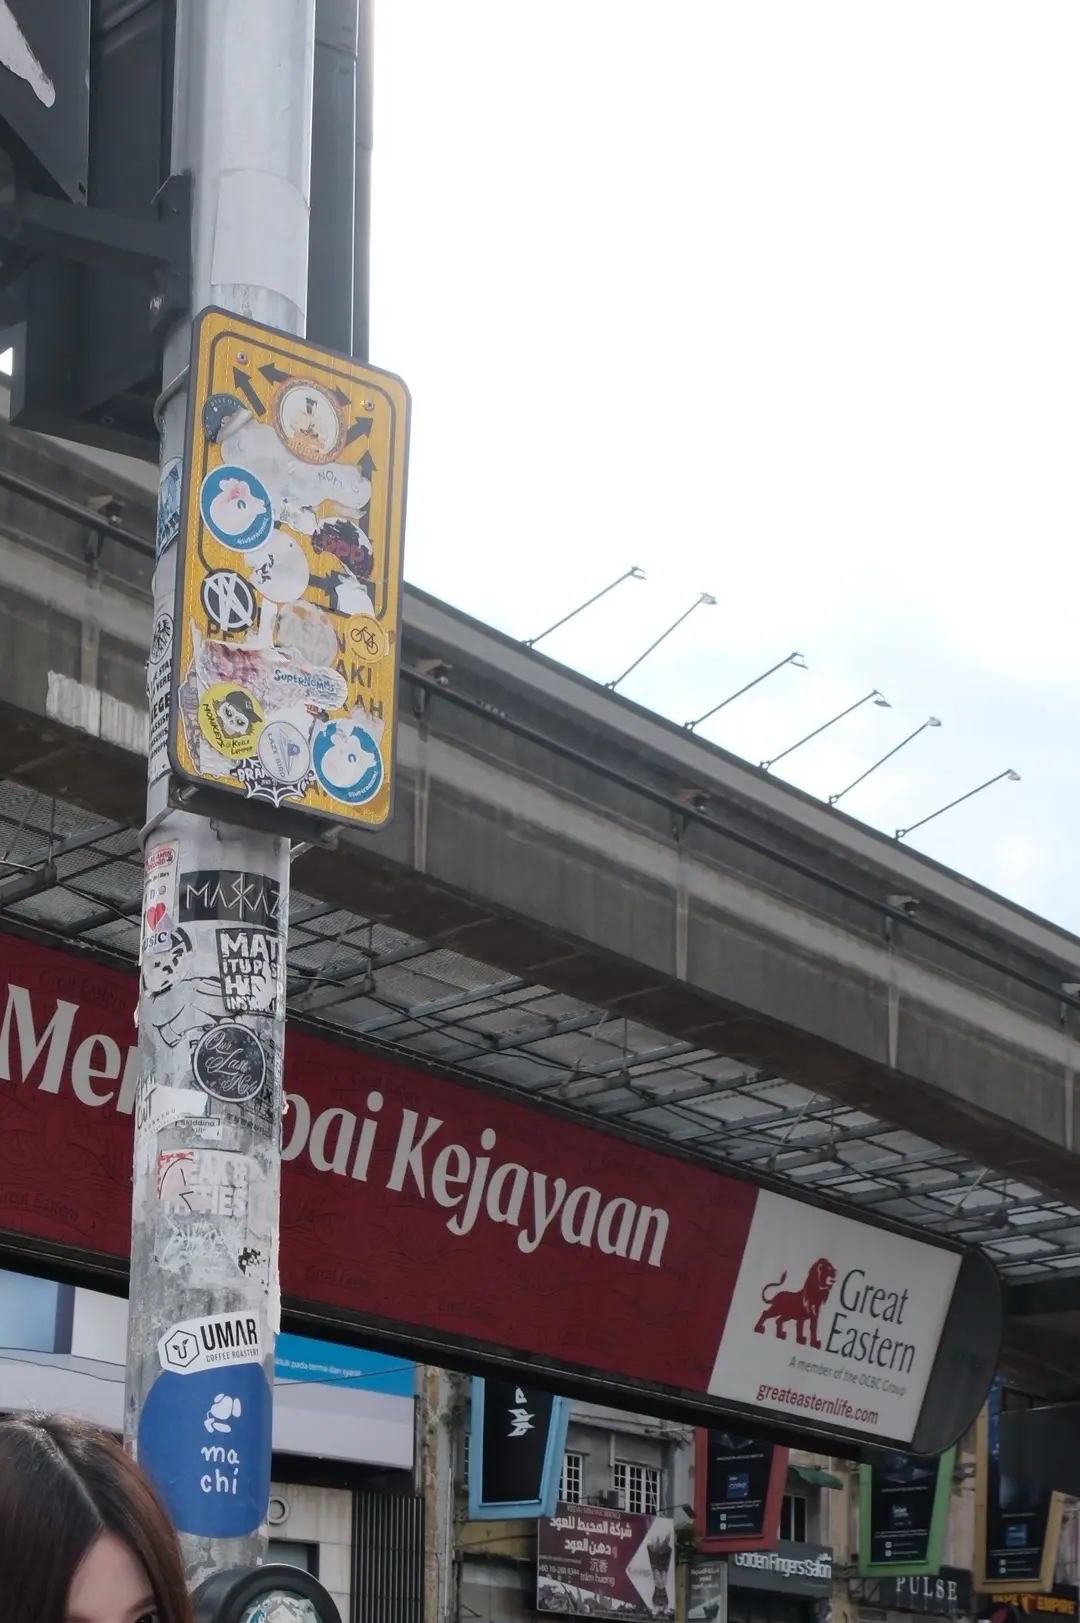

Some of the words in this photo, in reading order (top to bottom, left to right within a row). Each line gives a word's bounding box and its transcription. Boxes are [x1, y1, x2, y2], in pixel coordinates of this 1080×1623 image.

[385, 1108, 669, 1268] Kejayaan
[840, 1268, 910, 1325] Great
[200, 1318, 259, 1351] UMAR
[825, 1311, 916, 1374] Eastern
[206, 1351, 231, 1363] COFFEE
[232, 1348, 259, 1359] ROASTERY
[788, 1355, 796, 1368] A
[798, 1360, 832, 1377] member
[833, 1367, 843, 1380] of
[845, 1370, 857, 1384] the
[859, 1373, 880, 1389] OCBC
[882, 1379, 907, 1399] Group
[756, 1383, 879, 1425] greateasternlife.com
[201, 1445, 240, 1465] ma
[200, 1467, 239, 1495] chi
[735, 1552, 769, 1571] Golden
[770, 1553, 804, 1577] Fingers
[805, 1559, 832, 1579] Salon
[896, 1576, 958, 1601] PULSE
